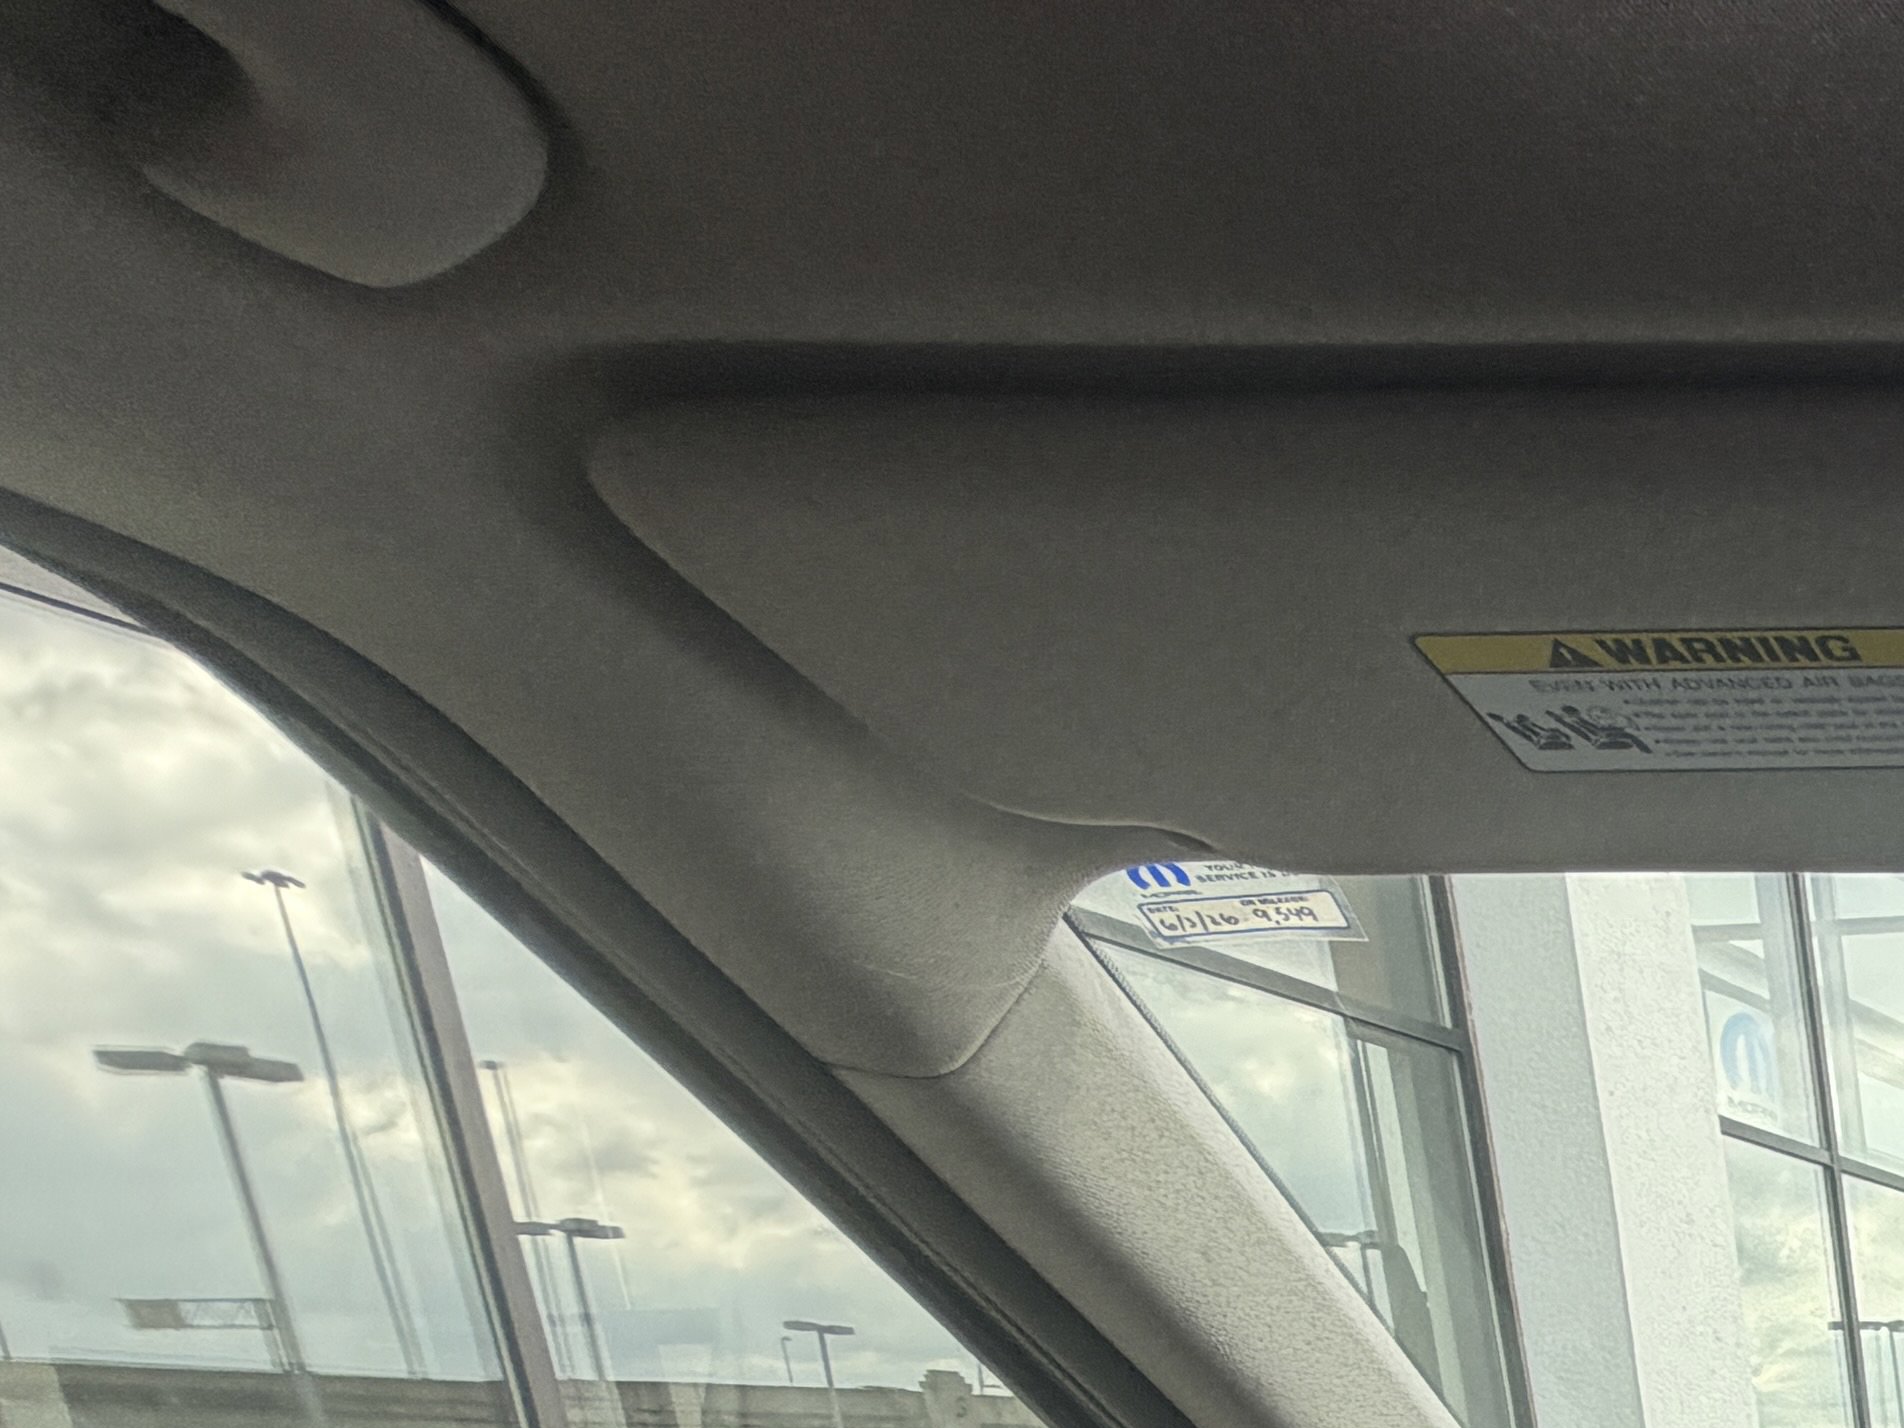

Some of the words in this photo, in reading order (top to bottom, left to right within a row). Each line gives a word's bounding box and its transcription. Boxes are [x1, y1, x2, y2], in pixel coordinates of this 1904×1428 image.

[1594, 635, 1862, 665] WARNING
[1605, 677, 1661, 691] WITH
[1671, 675, 1792, 690] ADVANCED
[1800, 675, 1840, 687] AIR
[1195, 872, 1258, 883] SERVICE
